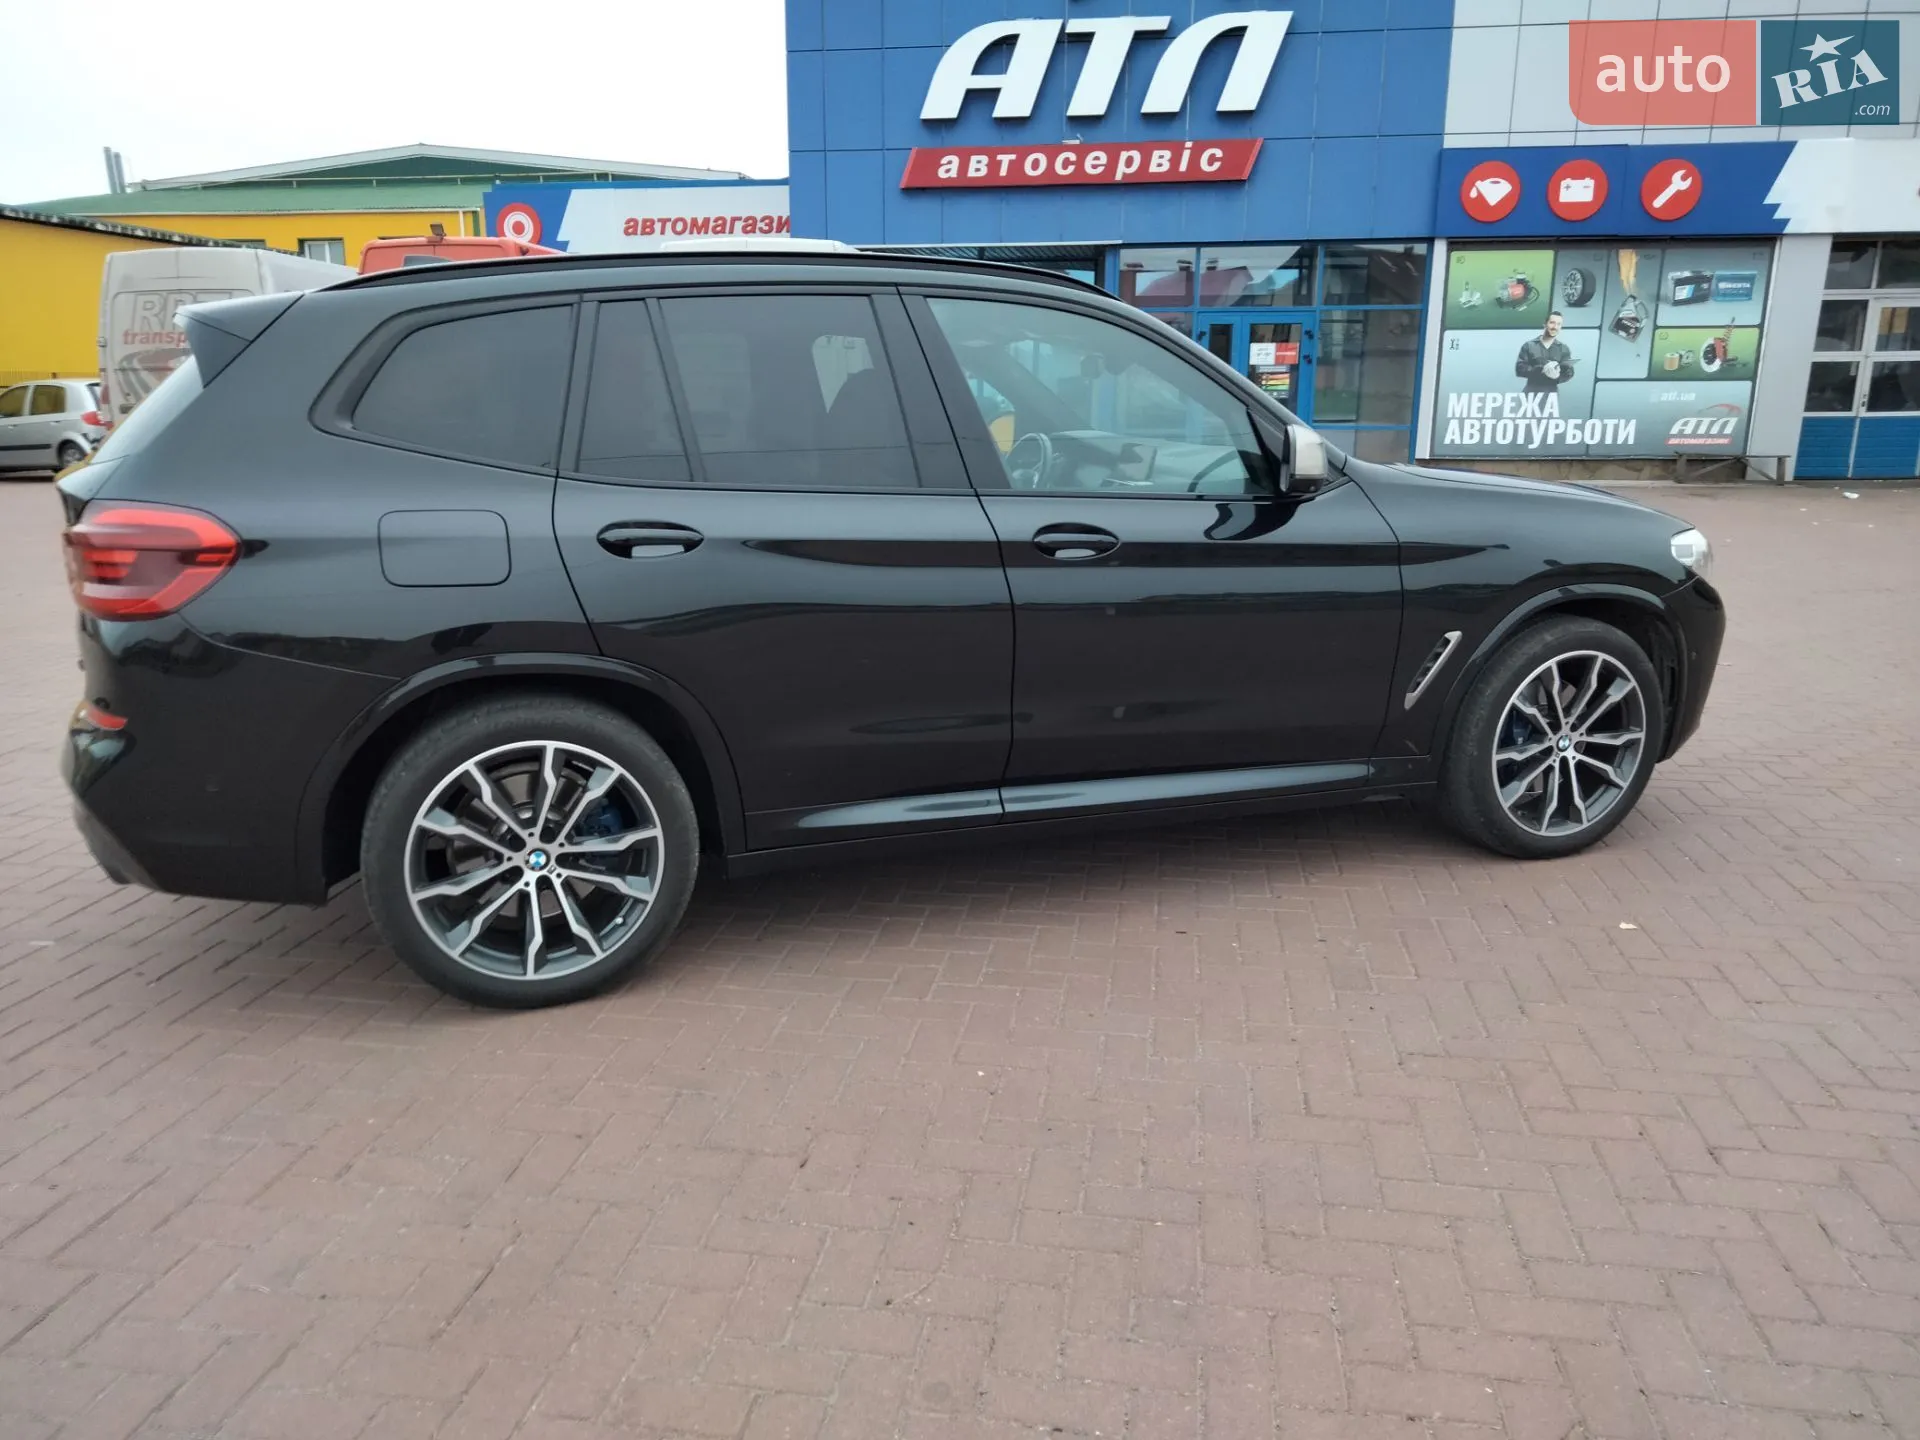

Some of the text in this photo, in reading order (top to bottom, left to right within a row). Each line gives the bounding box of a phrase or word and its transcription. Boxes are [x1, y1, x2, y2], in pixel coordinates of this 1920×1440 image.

[920, 11, 1294, 120] АТЛ
[937, 141, 1223, 181] автосервіс
[1447, 391, 1560, 418] МЕРЕЖА
[1443, 418, 1637, 449] АВТОТУРБОТИ
[1669, 417, 1738, 435] АТЛ
